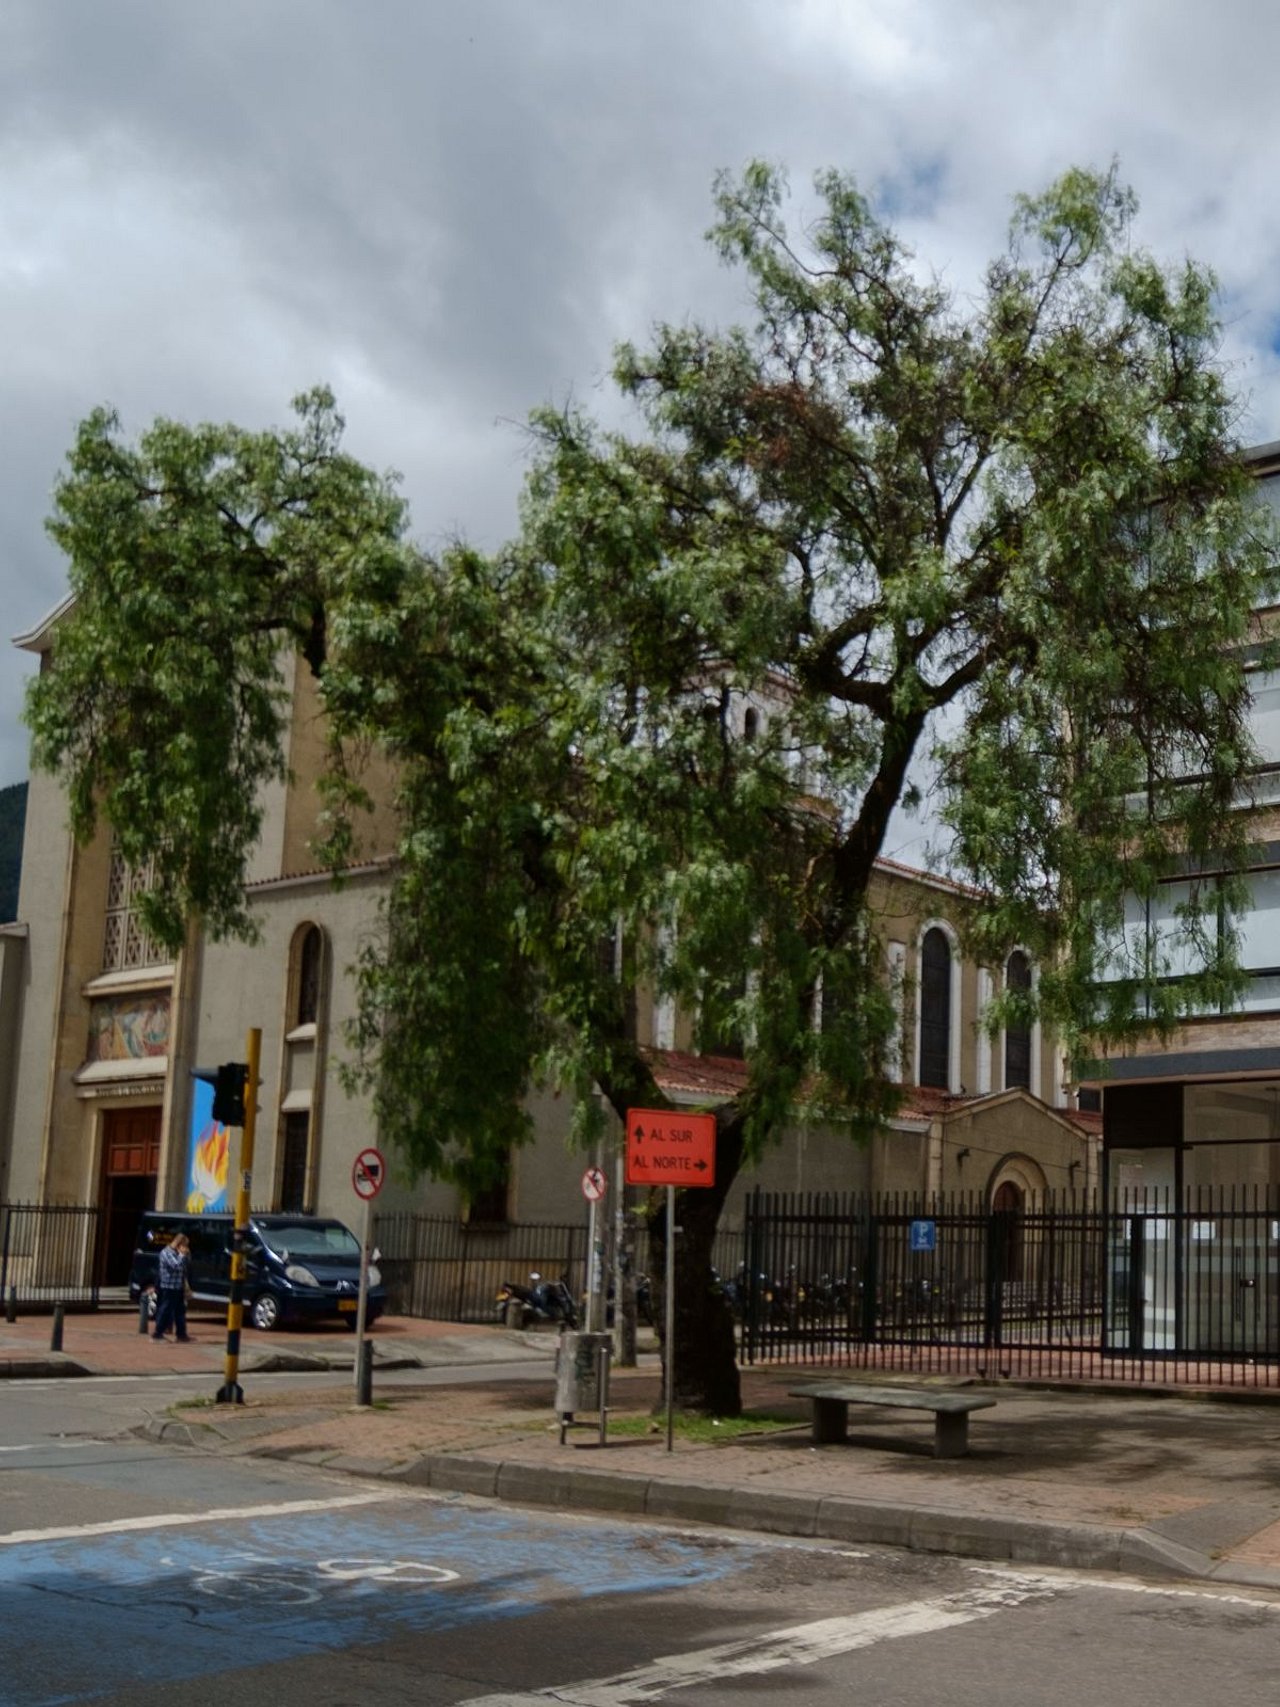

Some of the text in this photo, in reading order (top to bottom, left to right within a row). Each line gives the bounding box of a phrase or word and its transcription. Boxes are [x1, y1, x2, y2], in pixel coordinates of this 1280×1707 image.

[650, 1128, 693, 1143] AL SUR
[633, 1154, 692, 1170] AL NORTE
